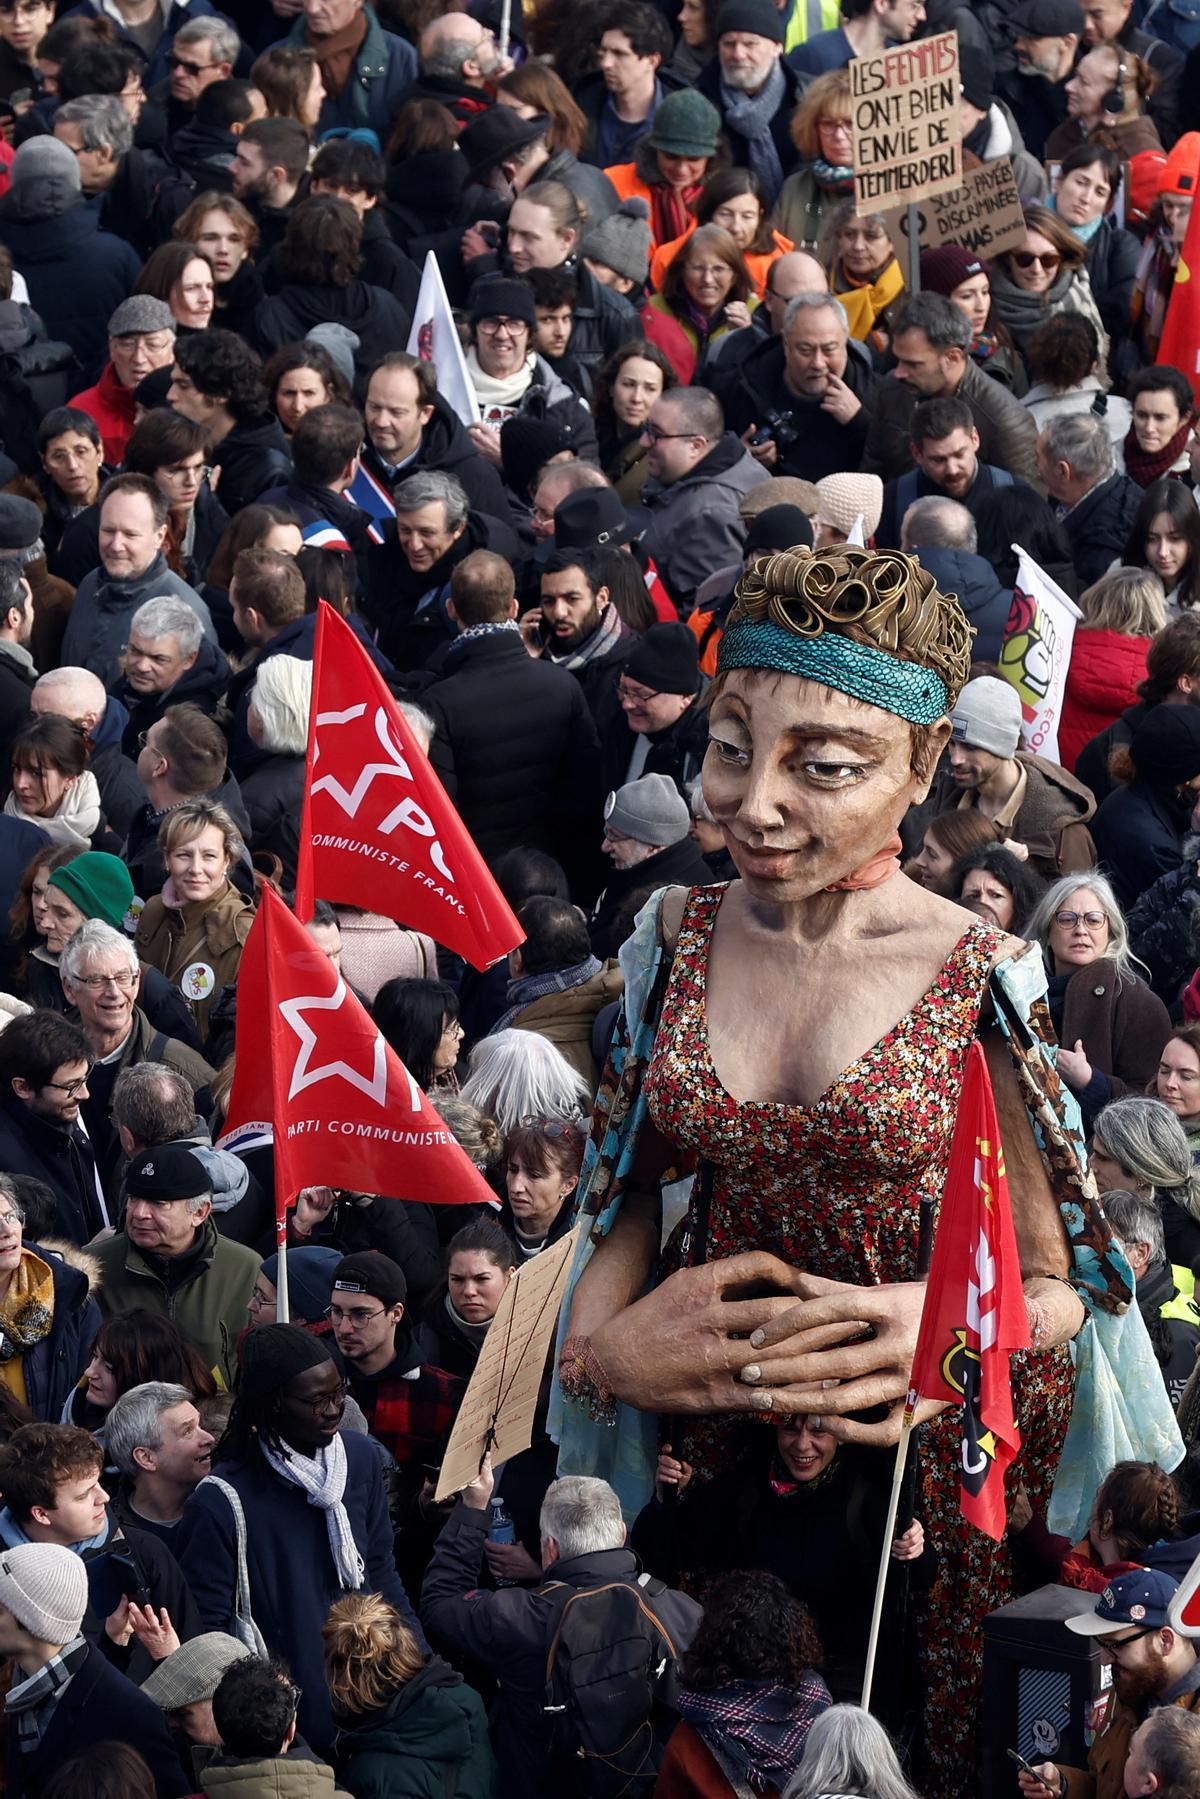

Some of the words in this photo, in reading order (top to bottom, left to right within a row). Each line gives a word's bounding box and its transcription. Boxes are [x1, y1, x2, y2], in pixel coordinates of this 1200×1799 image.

[853, 59, 885, 97] LES
[884, 34, 957, 88] FEMMES
[856, 94, 903, 131] ONT
[909, 78, 954, 119] BIEN
[859, 126, 919, 165] ENVIE
[928, 118, 950, 147] DE
[311, 834, 410, 873] OMMUNISTE
[287, 1119, 321, 1140] PARTI
[327, 1120, 448, 1146] COMMUNISTE
